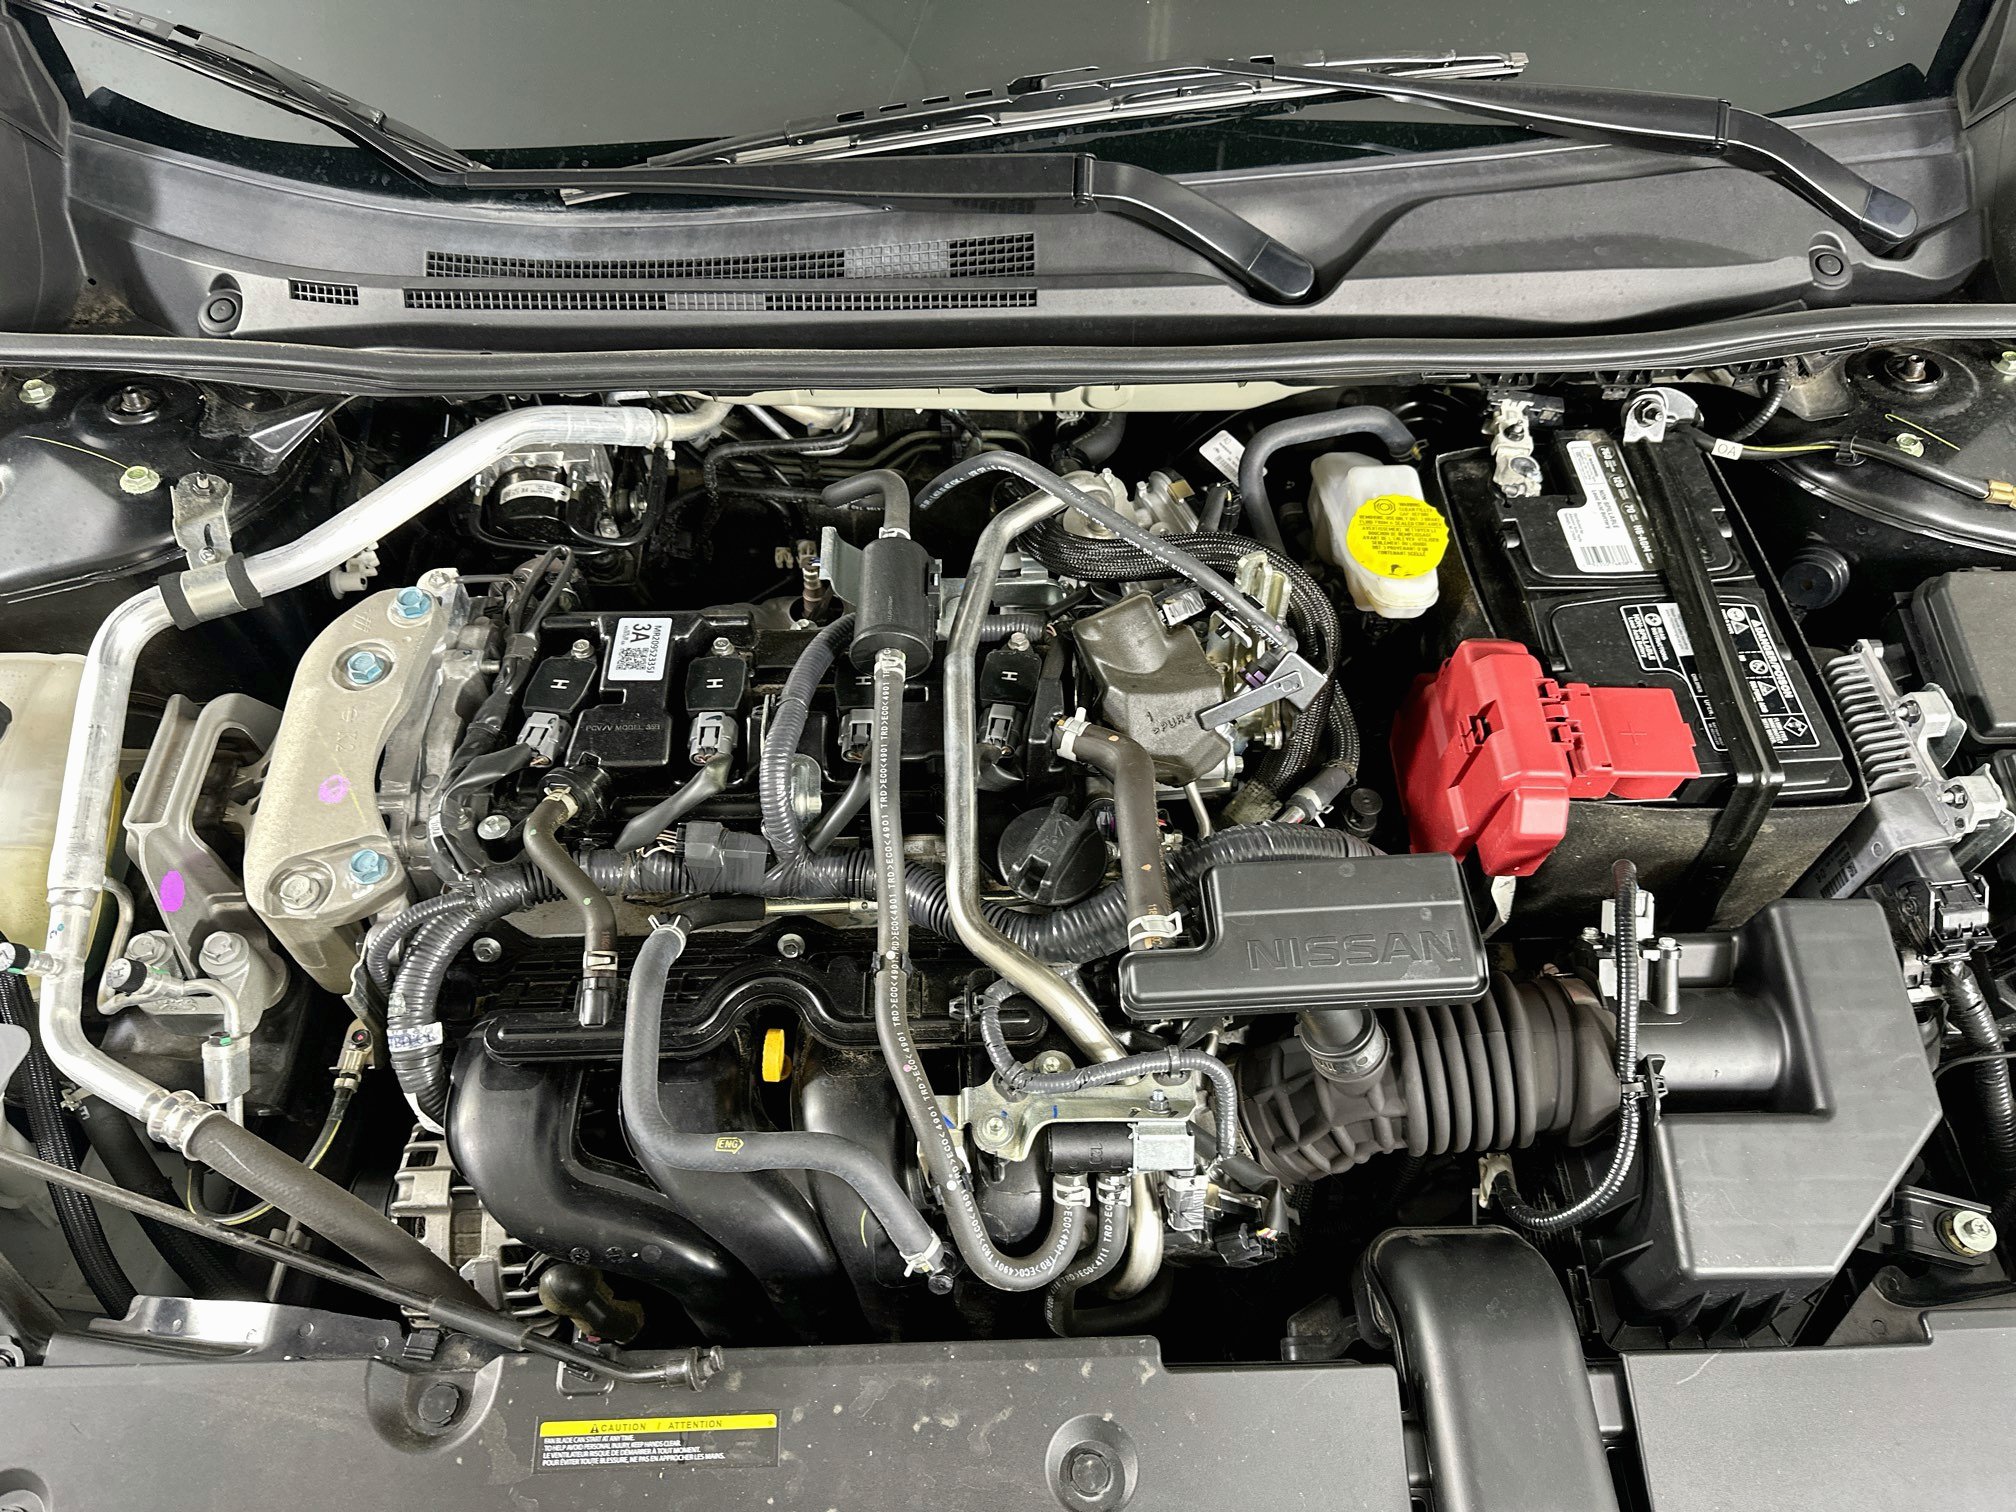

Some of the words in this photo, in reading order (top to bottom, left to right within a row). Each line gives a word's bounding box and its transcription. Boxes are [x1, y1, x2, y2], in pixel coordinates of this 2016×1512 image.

[630, 624, 652, 642] 3A
[1755, 625, 1794, 699] DANGER/POISON
[880, 681, 890, 740] TRD>ECO<4901
[880, 743, 888, 808] TRD>ECO<4901
[1246, 930, 1461, 970] NISSAN
[719, 1140, 739, 1148] ENG
[601, 1423, 646, 1432] CAUTION
[668, 1420, 723, 1430] ATTENTION
